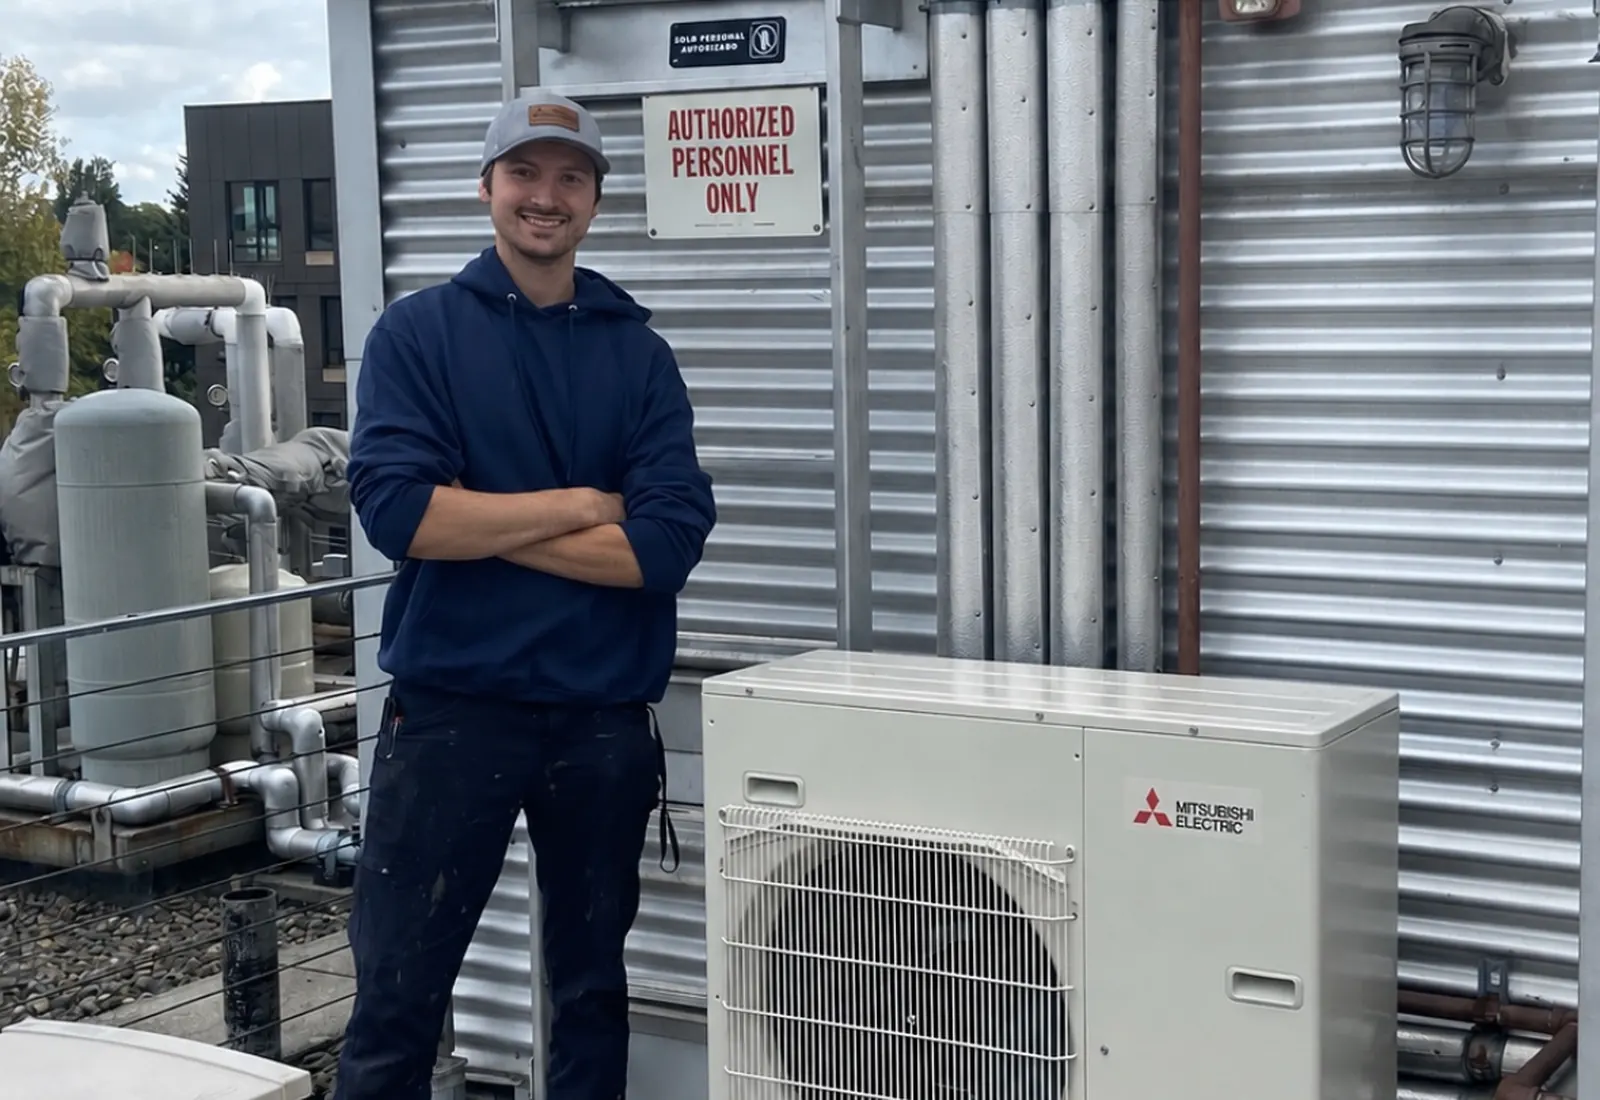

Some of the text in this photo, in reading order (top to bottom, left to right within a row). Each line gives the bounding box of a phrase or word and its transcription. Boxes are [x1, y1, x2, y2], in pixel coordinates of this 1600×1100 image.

[668, 105, 795, 141] AUTHORIZED
[672, 144, 794, 178] PERSONNEL
[706, 182, 758, 213] ONLY
[1176, 800, 1254, 821] MITSUBISHI
[1176, 815, 1243, 834] ELECTRIC
